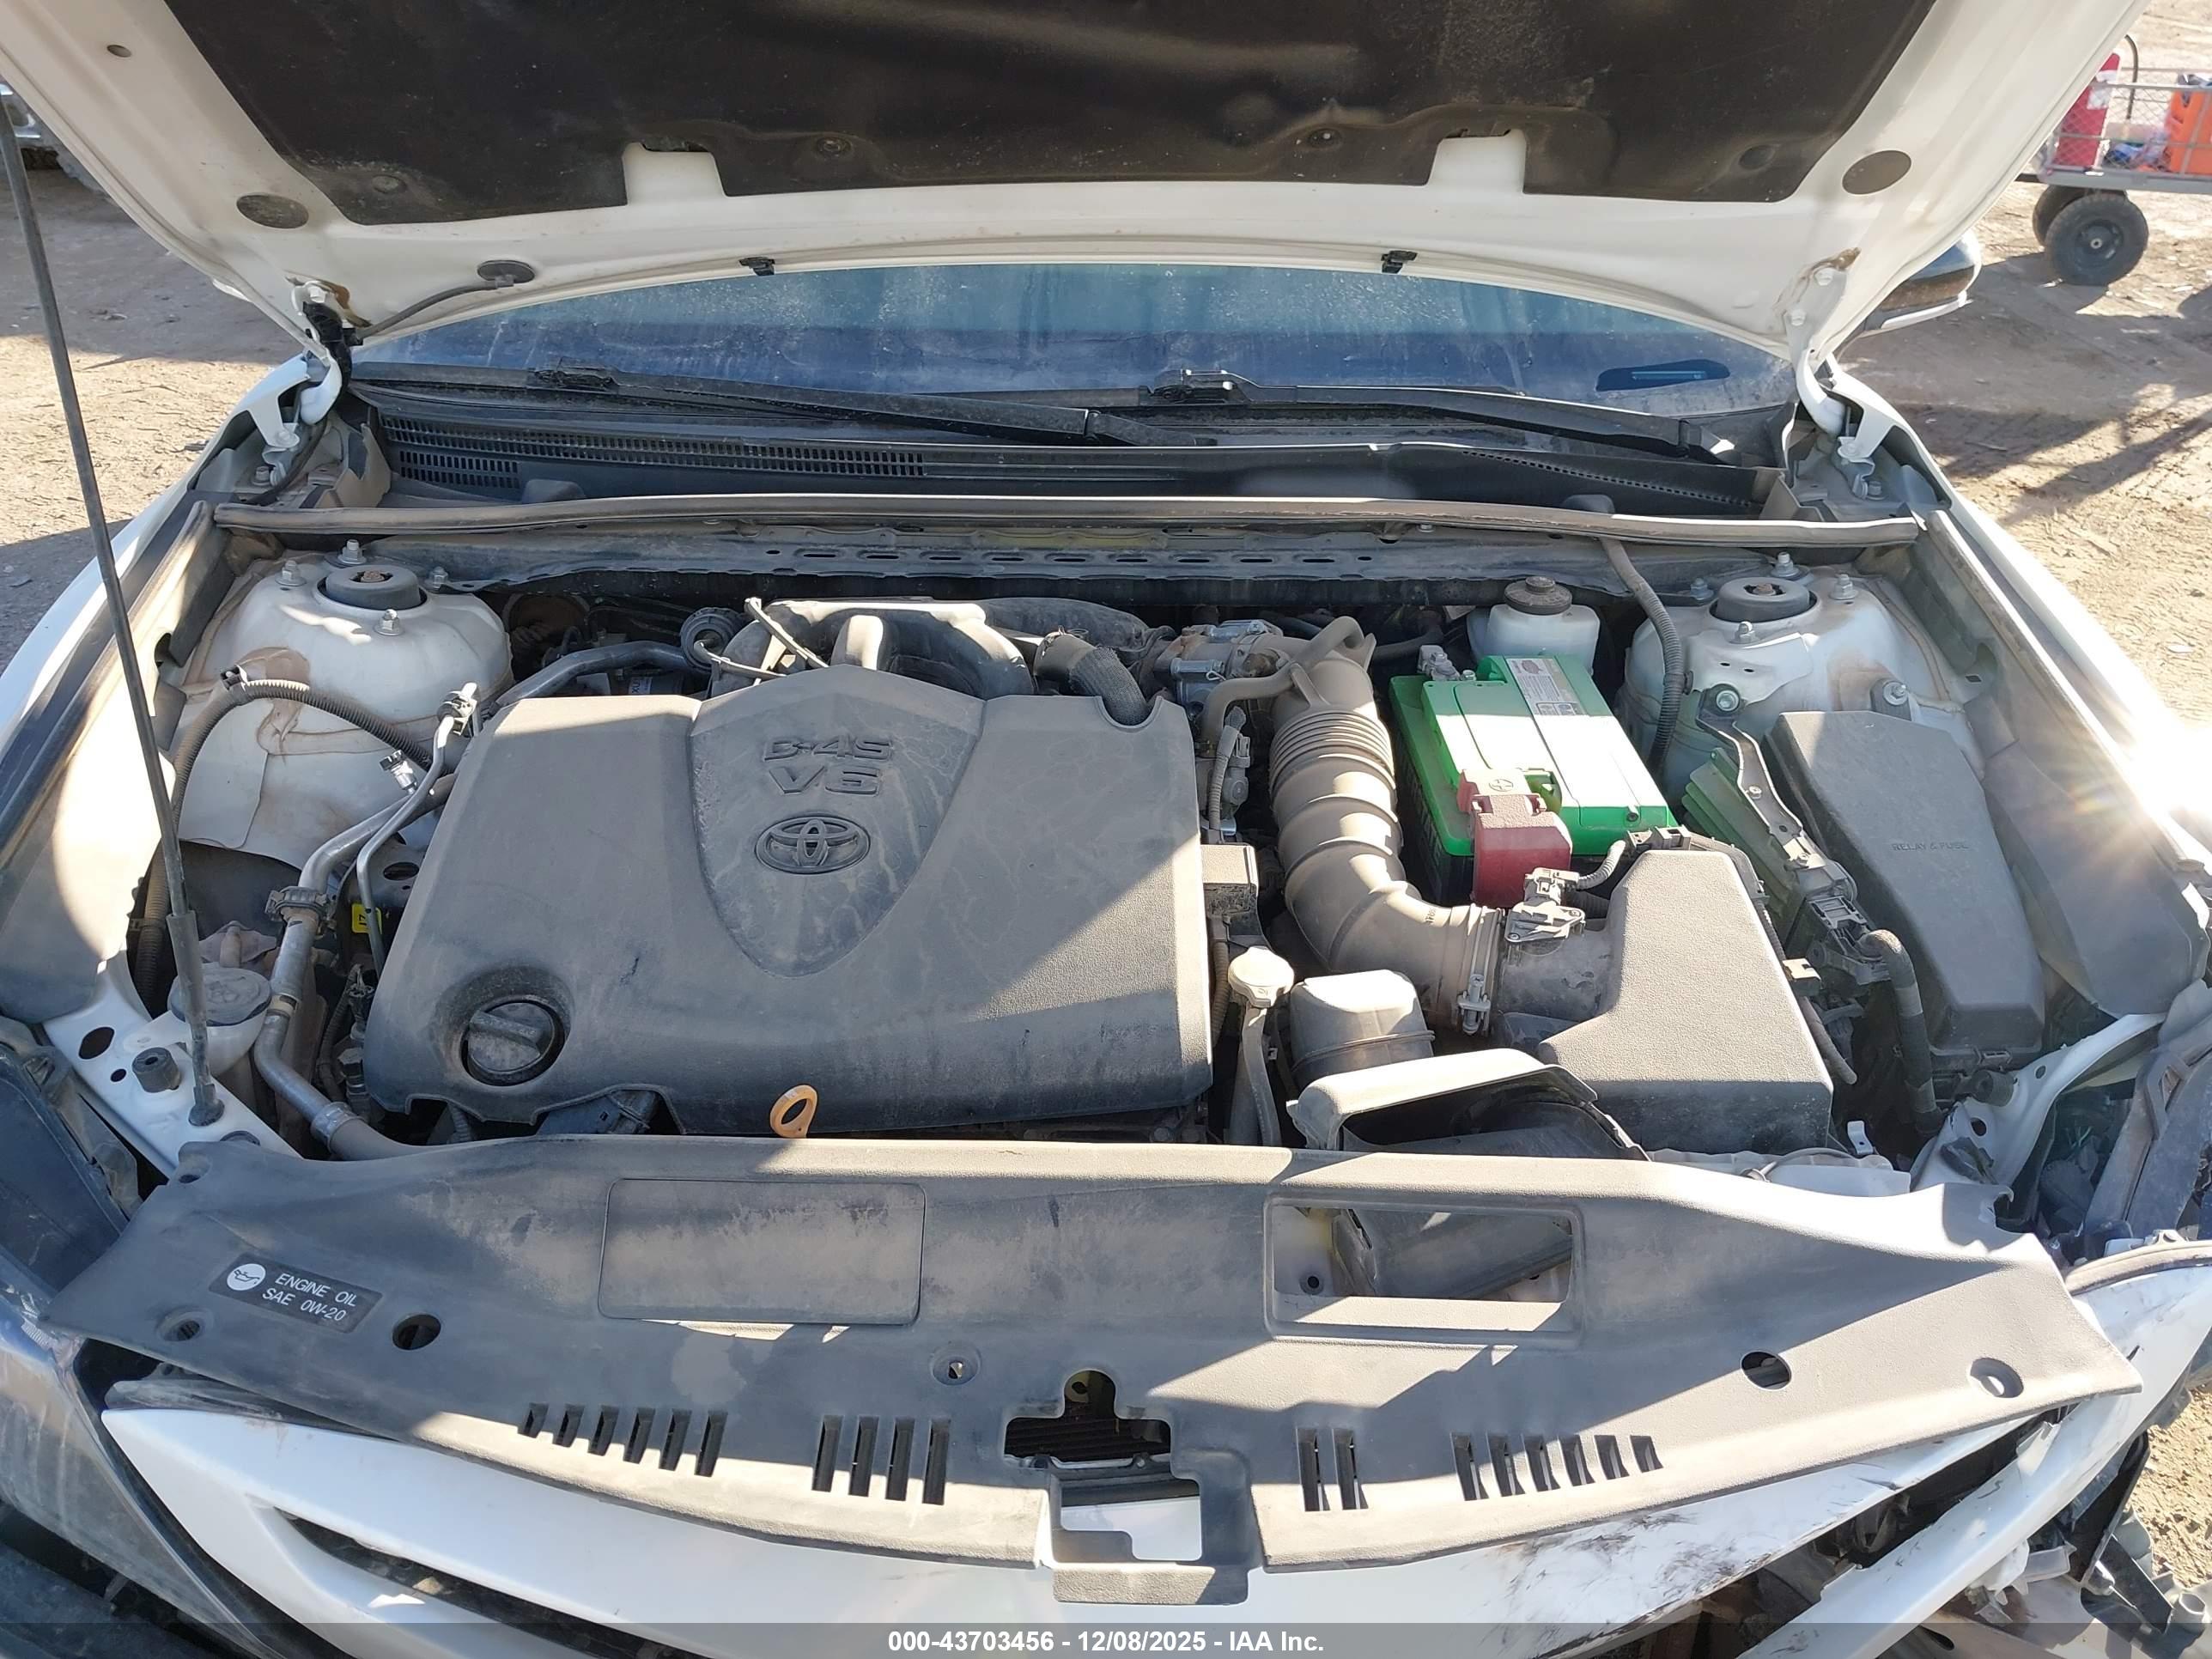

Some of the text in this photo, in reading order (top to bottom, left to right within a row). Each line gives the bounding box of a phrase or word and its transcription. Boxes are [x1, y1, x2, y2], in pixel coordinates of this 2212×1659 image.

[763, 735, 892, 762] D-4S
[769, 765, 880, 797] V6
[1891, 842, 1926, 851] RELAY
[262, 1288, 346, 1322] SAE 0W-20
[275, 1273, 357, 1307] ENGINE OIL
